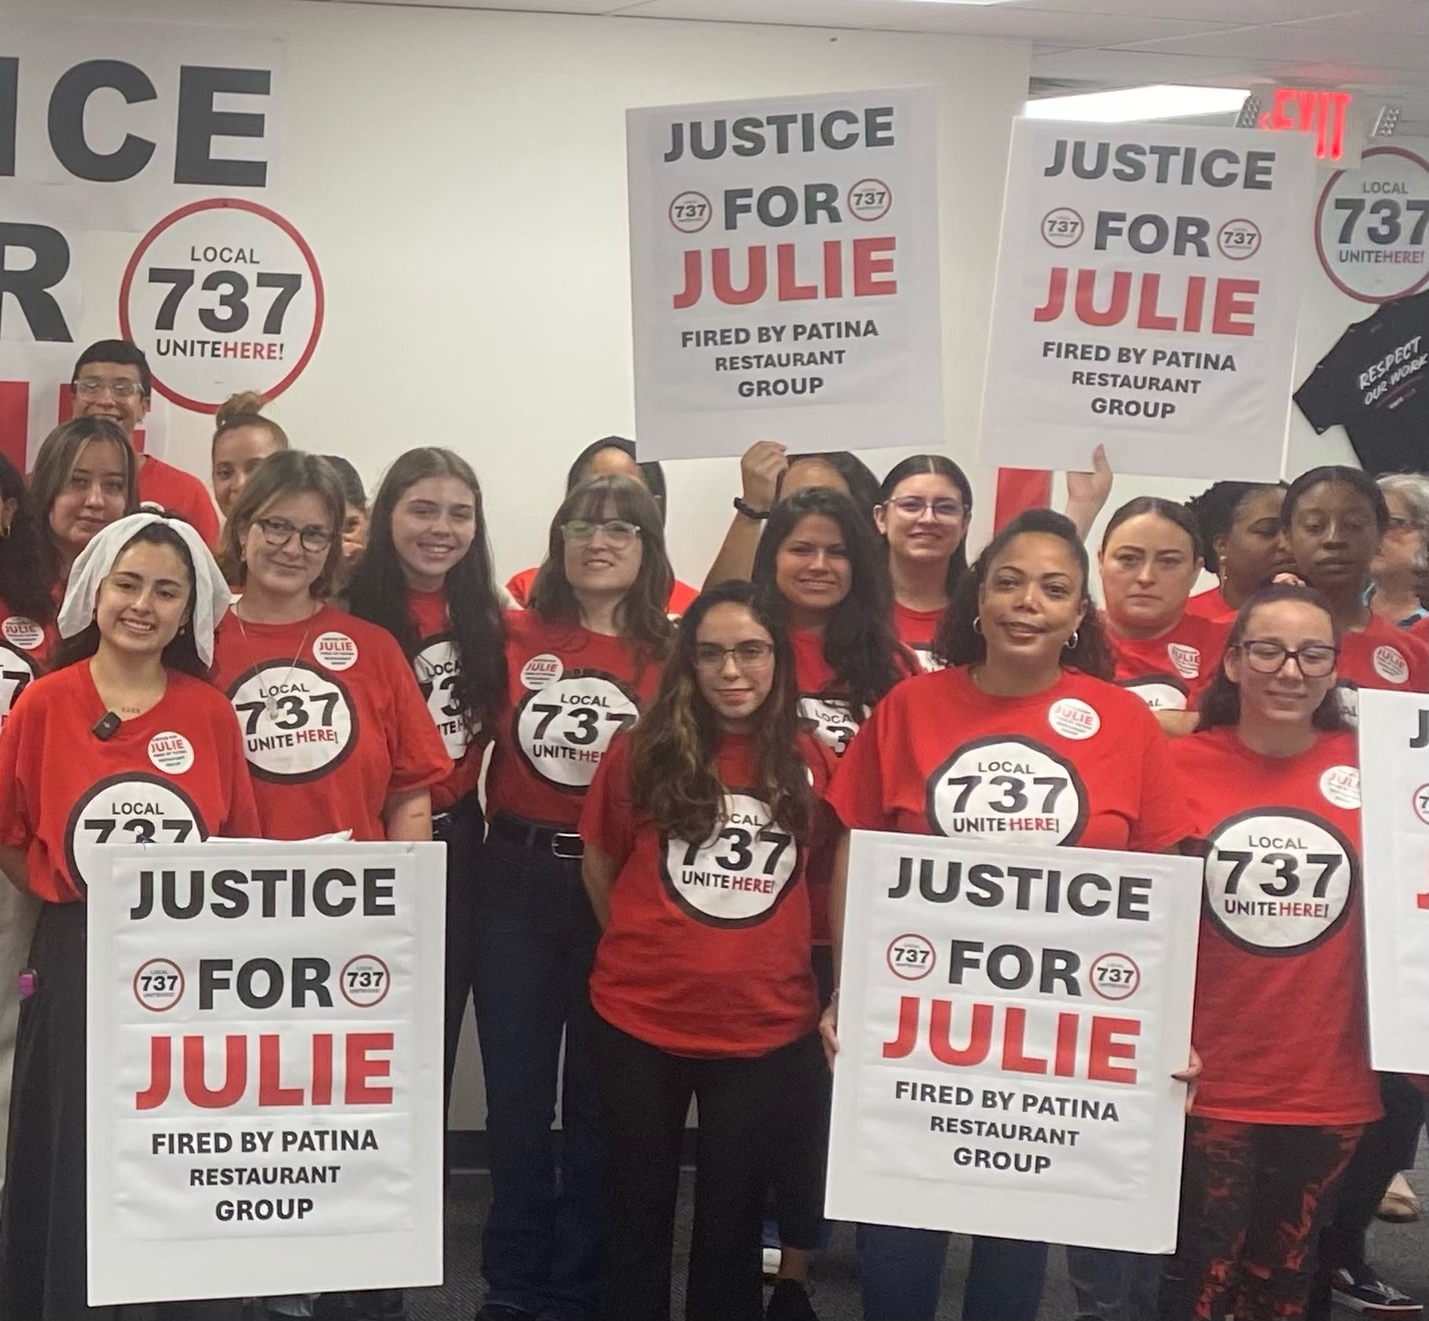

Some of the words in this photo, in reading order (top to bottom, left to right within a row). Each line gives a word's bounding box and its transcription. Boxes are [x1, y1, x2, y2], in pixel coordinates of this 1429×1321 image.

[664, 106, 895, 163] JUSTICE
[1043, 139, 1277, 191] JUSTICE
[853, 191, 887, 207] 737
[1362, 181, 1409, 195] LOCAL
[674, 203, 707, 218] 737
[723, 183, 843, 231] FOR
[1047, 220, 1079, 234] 737
[1094, 210, 1211, 258] FOR
[1334, 197, 1429, 246] 737
[1223, 231, 1257, 246] 737
[190, 245, 261, 265] LOCAL
[673, 236, 898, 309] JULIE
[147, 267, 303, 336] 737
[1033, 266, 1261, 337] JULIE
[681, 326, 751, 348] FIRED
[757, 325, 787, 343] BY
[792, 319, 879, 342] PATINA
[715, 350, 846, 372] RESTAURANT
[1042, 341, 1111, 363] FIRED
[1117, 346, 1148, 365] BY
[1152, 348, 1237, 372] PATINA
[1359, 336, 1422, 391] RESPECT
[738, 377, 825, 398] GROUP
[1071, 370, 1202, 394] RESTAURANT
[1364, 379, 1387, 406] OUR
[1390, 352, 1429, 386] WORK
[1090, 397, 1176, 419] GROUP
[319, 641, 353, 651] JULIE
[525, 662, 558, 673] JULIE
[259, 682, 310, 699] LOCAL
[560, 693, 610, 708] LOCAL
[235, 691, 340, 735] 737
[531, 703, 639, 745] 737
[1055, 706, 1094, 726] JULIE
[151, 739, 185, 754] JULIE
[246, 733, 294, 754] UNITE
[295, 729, 339, 745] HERE!
[977, 761, 1036, 776] LOCAL
[947, 775, 1069, 816] 737
[111, 802, 165, 816] LOCAL
[1248, 834, 1308, 850] LOCAL
[1217, 851, 1343, 899] 737
[129, 867, 396, 921] JUSTICE
[887, 856, 1153, 922] JUSTICE
[893, 947, 930, 965] 737
[948, 939, 1082, 997] FOR
[140, 975, 179, 992] 737
[198, 957, 333, 1011] FOR
[346, 971, 385, 988] 737
[1096, 966, 1135, 984] 737
[882, 995, 1141, 1085] JULIE
[135, 1032, 395, 1111] JULIE
[895, 1080, 974, 1108] FIRED
[981, 1091, 1015, 1111] BY
[1021, 1094, 1120, 1122] PATINA
[151, 1131, 233, 1155] FIRED
[241, 1130, 274, 1153] BY
[281, 1129, 379, 1153] PATINA
[930, 1115, 1080, 1147] RESTAURANT
[953, 1146, 1051, 1175] GROUP
[189, 1165, 341, 1187] RESTAURANT
[215, 1198, 314, 1222] GROUP
